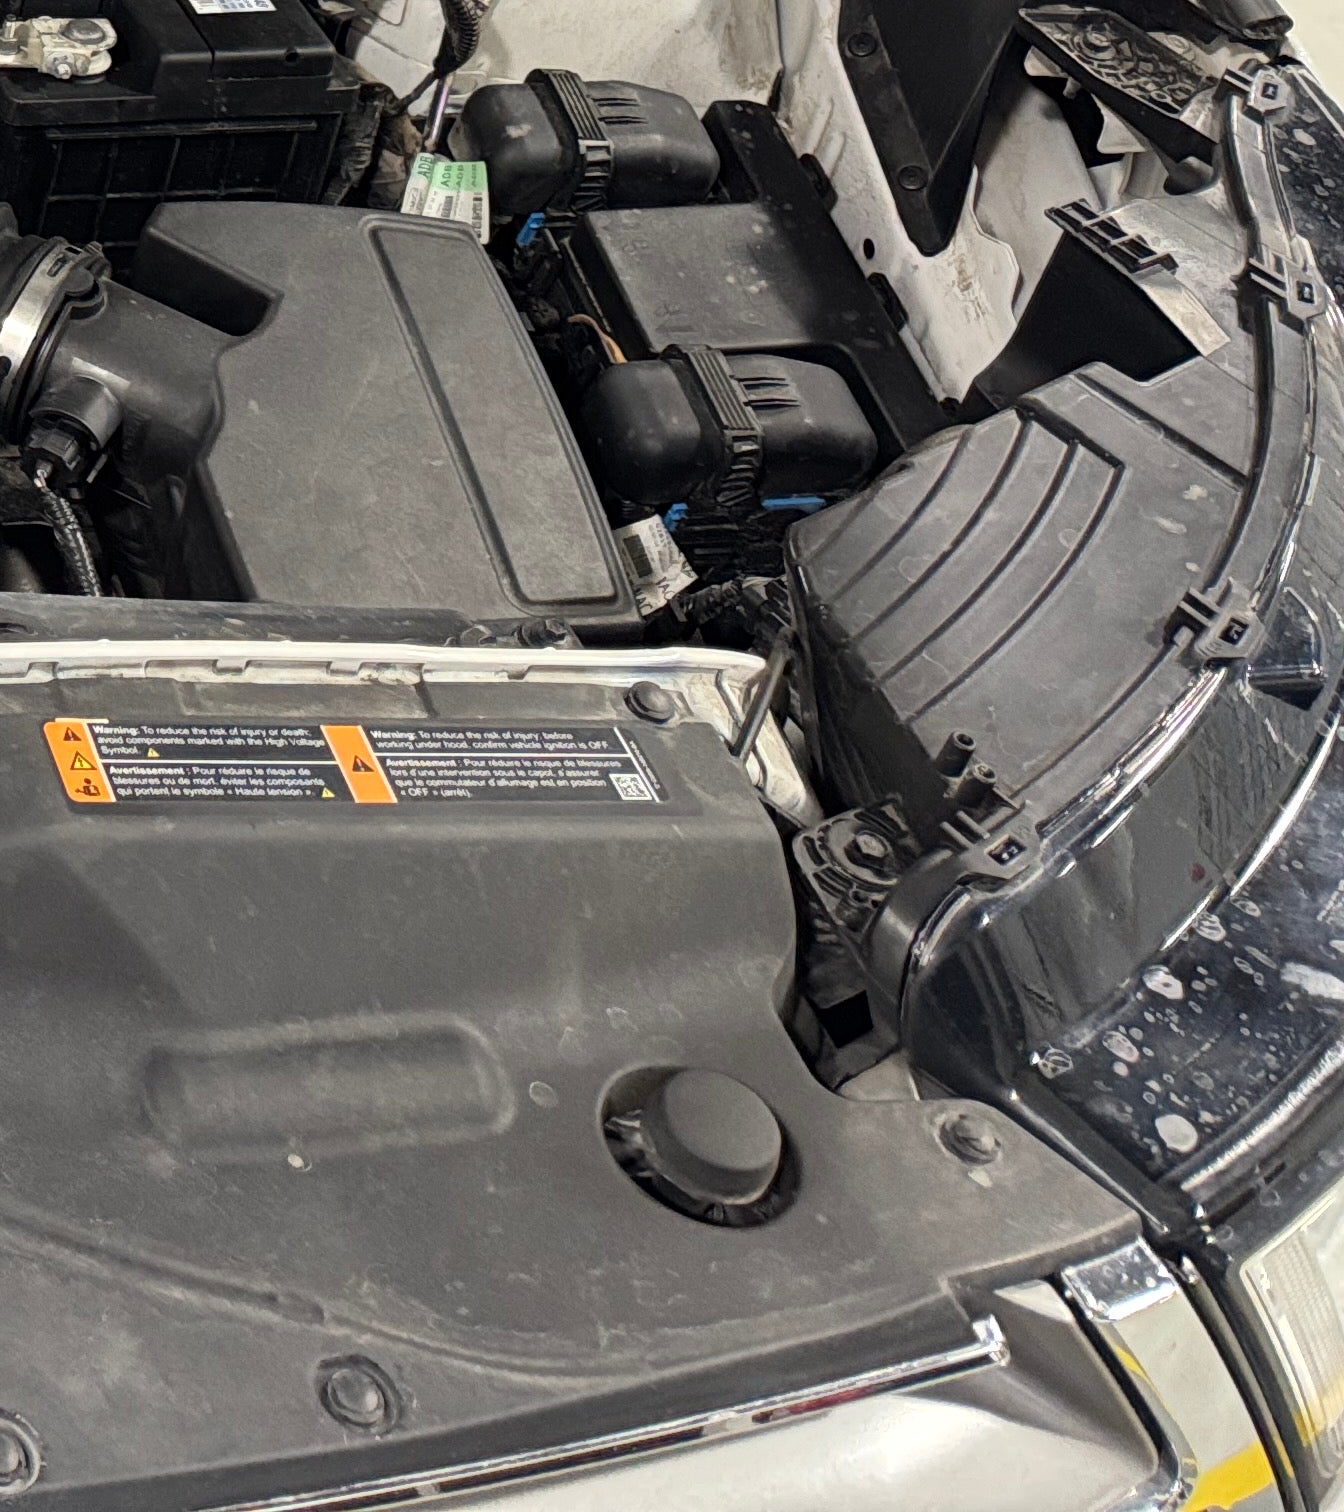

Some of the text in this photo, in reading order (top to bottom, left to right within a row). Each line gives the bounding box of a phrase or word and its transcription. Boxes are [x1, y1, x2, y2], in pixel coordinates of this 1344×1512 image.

[92, 725, 140, 736] Warning:
[140, 726, 154, 734] To
[156, 727, 190, 735] reduce
[191, 727, 208, 735] the
[209, 727, 227, 736] risk
[228, 726, 238, 736] of
[240, 728, 266, 737] injury
[370, 730, 417, 740] Warning:
[418, 730, 430, 739] To
[432, 731, 464, 739] reduce
[484, 732, 500, 740] risk
[502, 732, 511, 740] of
[542, 732, 573, 740] before
[97, 736, 124, 744] avoid
[126, 737, 185, 745] components
[187, 737, 224, 745] marked
[247, 738, 263, 746] the
[264, 738, 288, 748] High
[288, 738, 325, 748] Voltage
[376, 740, 414, 750] working
[472, 740, 507, 749] confirm
[509, 741, 541, 749] vehicle
[543, 741, 578, 750] ignition
[578, 741, 587, 749] is
[386, 758, 456, 768] Avertissement
[464, 758, 486, 767] Pour
[522, 760, 531, 768] le
[533, 760, 562, 768] risque
[564, 760, 576, 768] de
[577, 760, 622, 768] blessures
[110, 766, 184, 775] Avertissement
[192, 767, 216, 775] Pour
[254, 768, 264, 776] le
[266, 768, 296, 777] risque
[389, 768, 408, 776] lors
[436, 768, 492, 777] intervention
[516, 769, 526, 777] le
[112, 776, 160, 784] blessures
[178, 777, 190, 785] de
[249, 778, 264, 786] les
[266, 778, 326, 787] composants
[395, 779, 412, 788] que
[414, 778, 424, 786] le
[426, 778, 486, 787] commutateur
[540, 779, 554, 787] est
[570, 779, 607, 788] position
[116, 786, 132, 796] qui
[134, 787, 170, 796] portent
[170, 787, 181, 795] le
[182, 787, 224, 797] symbole
[234, 788, 266, 796] Haute
[266, 788, 304, 796] tension
[408, 788, 428, 796] OFF
